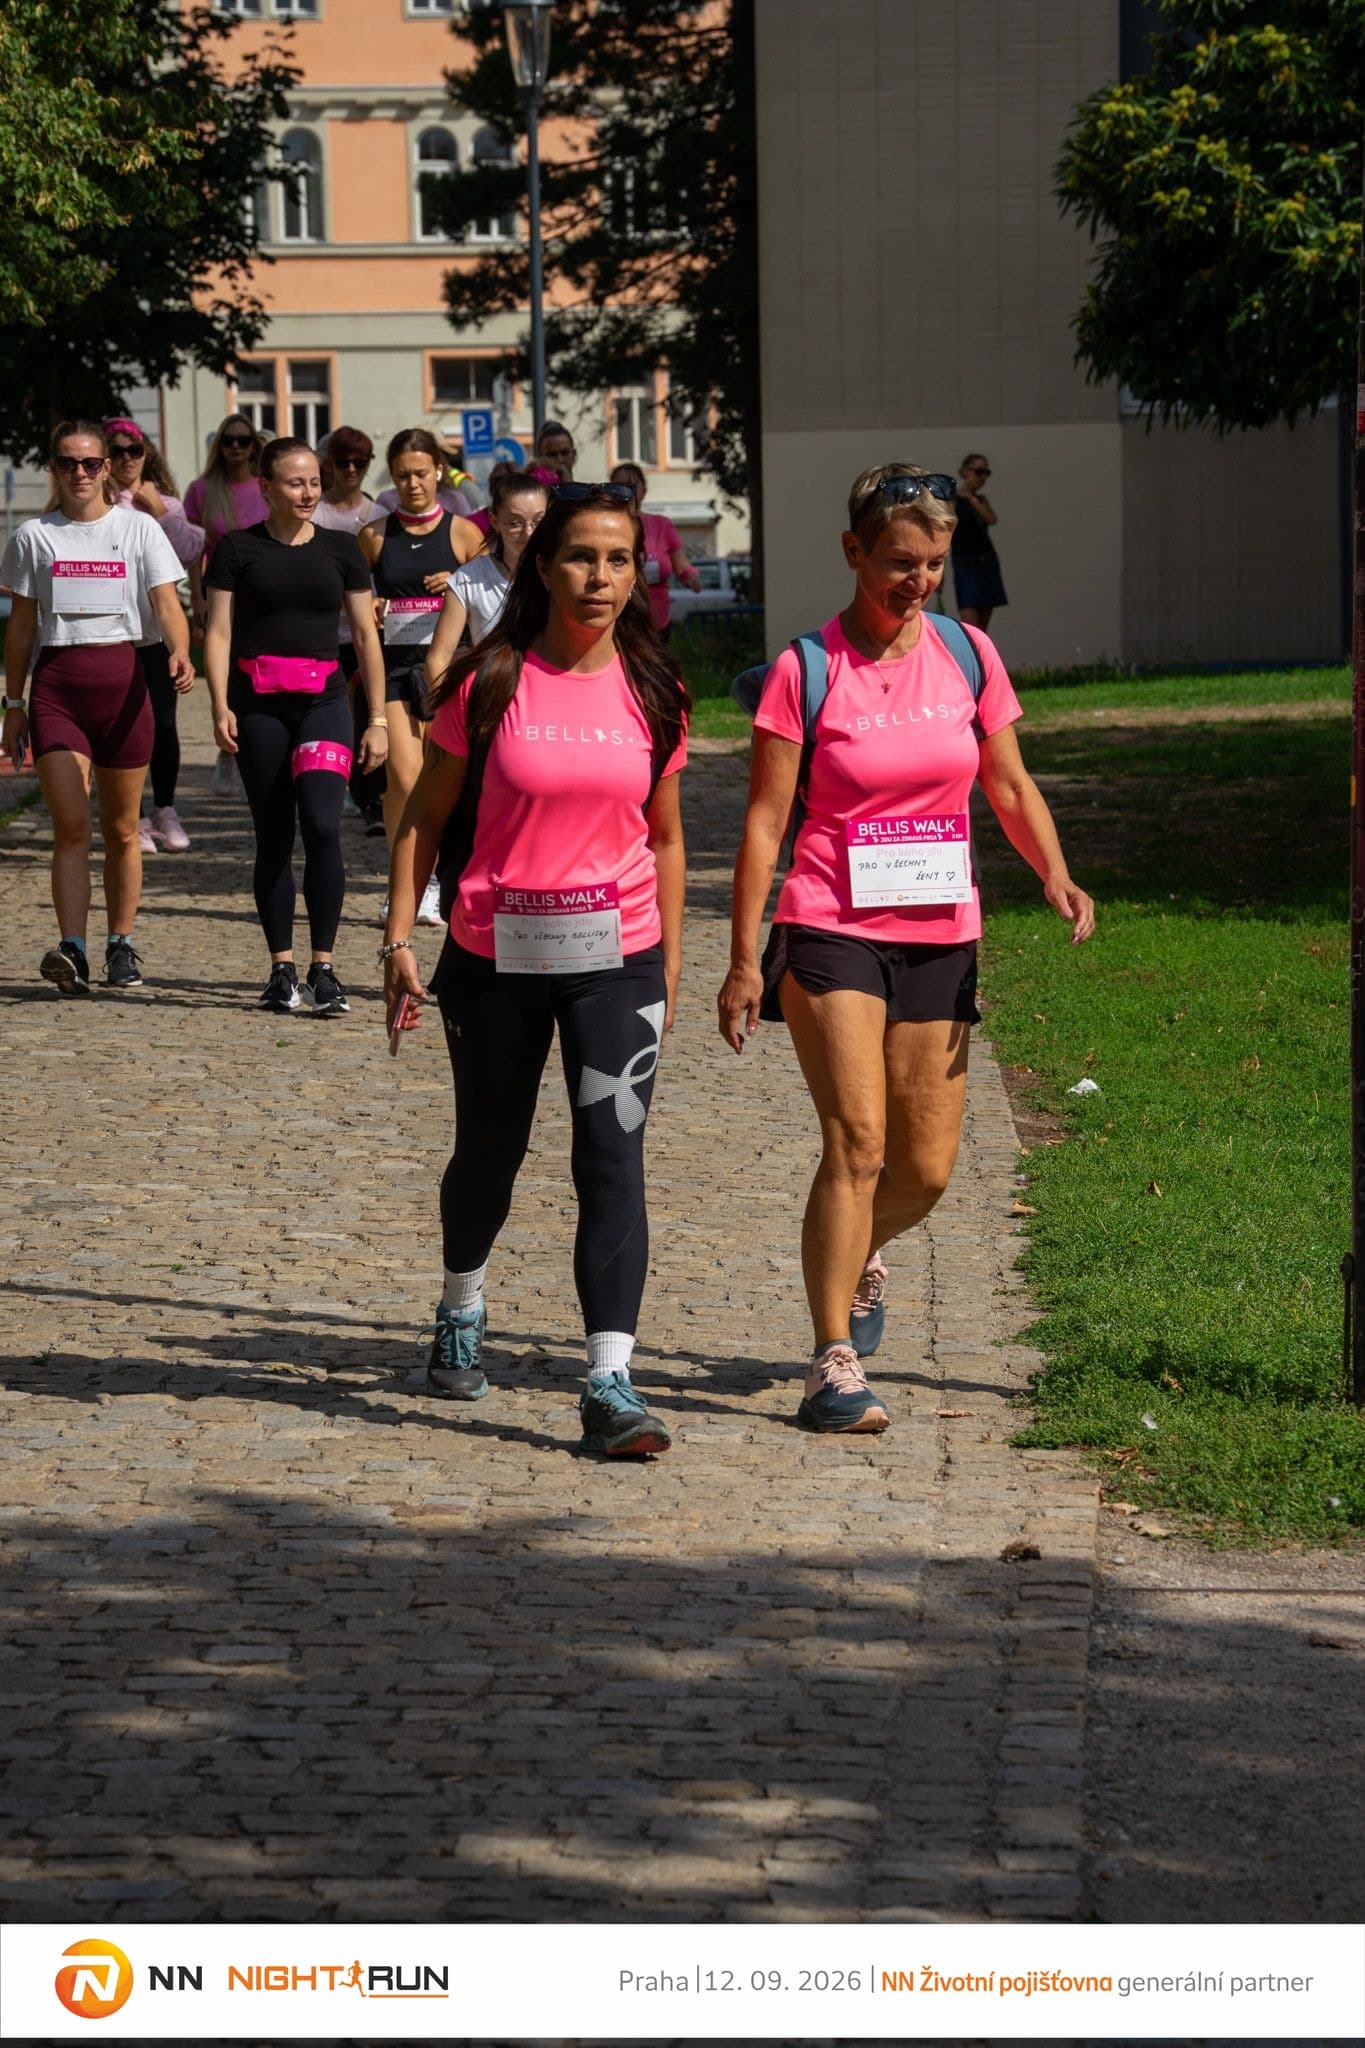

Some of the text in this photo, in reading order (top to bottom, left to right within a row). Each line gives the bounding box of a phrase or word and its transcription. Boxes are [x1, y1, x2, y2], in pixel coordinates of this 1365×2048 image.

[468, 415, 486, 441] P
[59, 563, 120, 573] BELLIS WALK
[415, 600, 439, 608] WALK
[858, 819, 956, 836] BELLIS WALK
[876, 847, 942, 858] Pro koho jdu
[858, 862, 878, 871] PRO
[504, 888, 607, 907] BELLIS WALK
[521, 918, 541, 928] Pro
